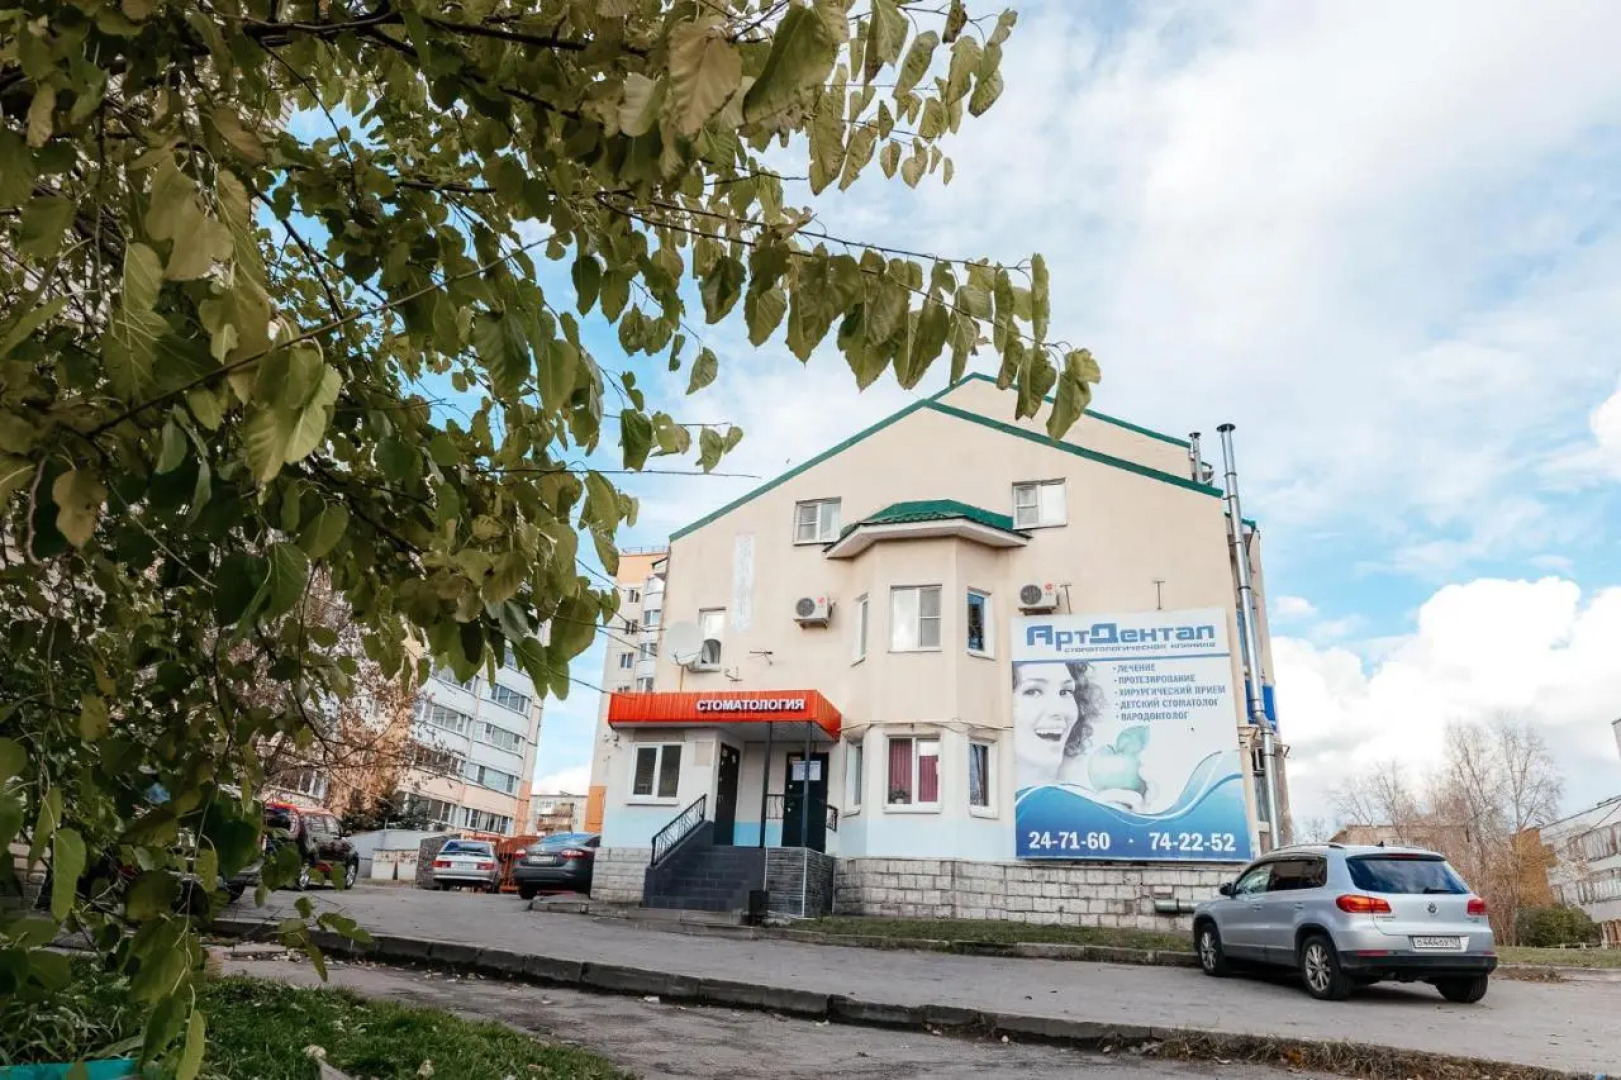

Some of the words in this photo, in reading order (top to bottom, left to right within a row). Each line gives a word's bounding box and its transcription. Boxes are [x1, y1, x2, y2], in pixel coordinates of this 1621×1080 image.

[1026, 623, 1215, 651] АртДентал
[1117, 663, 1155, 672] ЛЕЧЕНИЕ
[1118, 674, 1195, 684] ПРОТЕЗИРОВАНИЕ
[1119, 685, 1192, 696] ХИРУРГИЧЕСКИЙ
[1195, 685, 1226, 695] ПРИЕМ
[696, 698, 805, 713] СТОМАТОЛОГИЯ
[1120, 699, 1160, 710] ДЕТСКИЙ
[1162, 698, 1218, 708] СТОМАТОЛОГ
[1121, 711, 1188, 722] ПАРОДОНТОЛОГ
[1028, 831, 1111, 850] 24-71-60
[1149, 832, 1236, 852] 74-22-52
